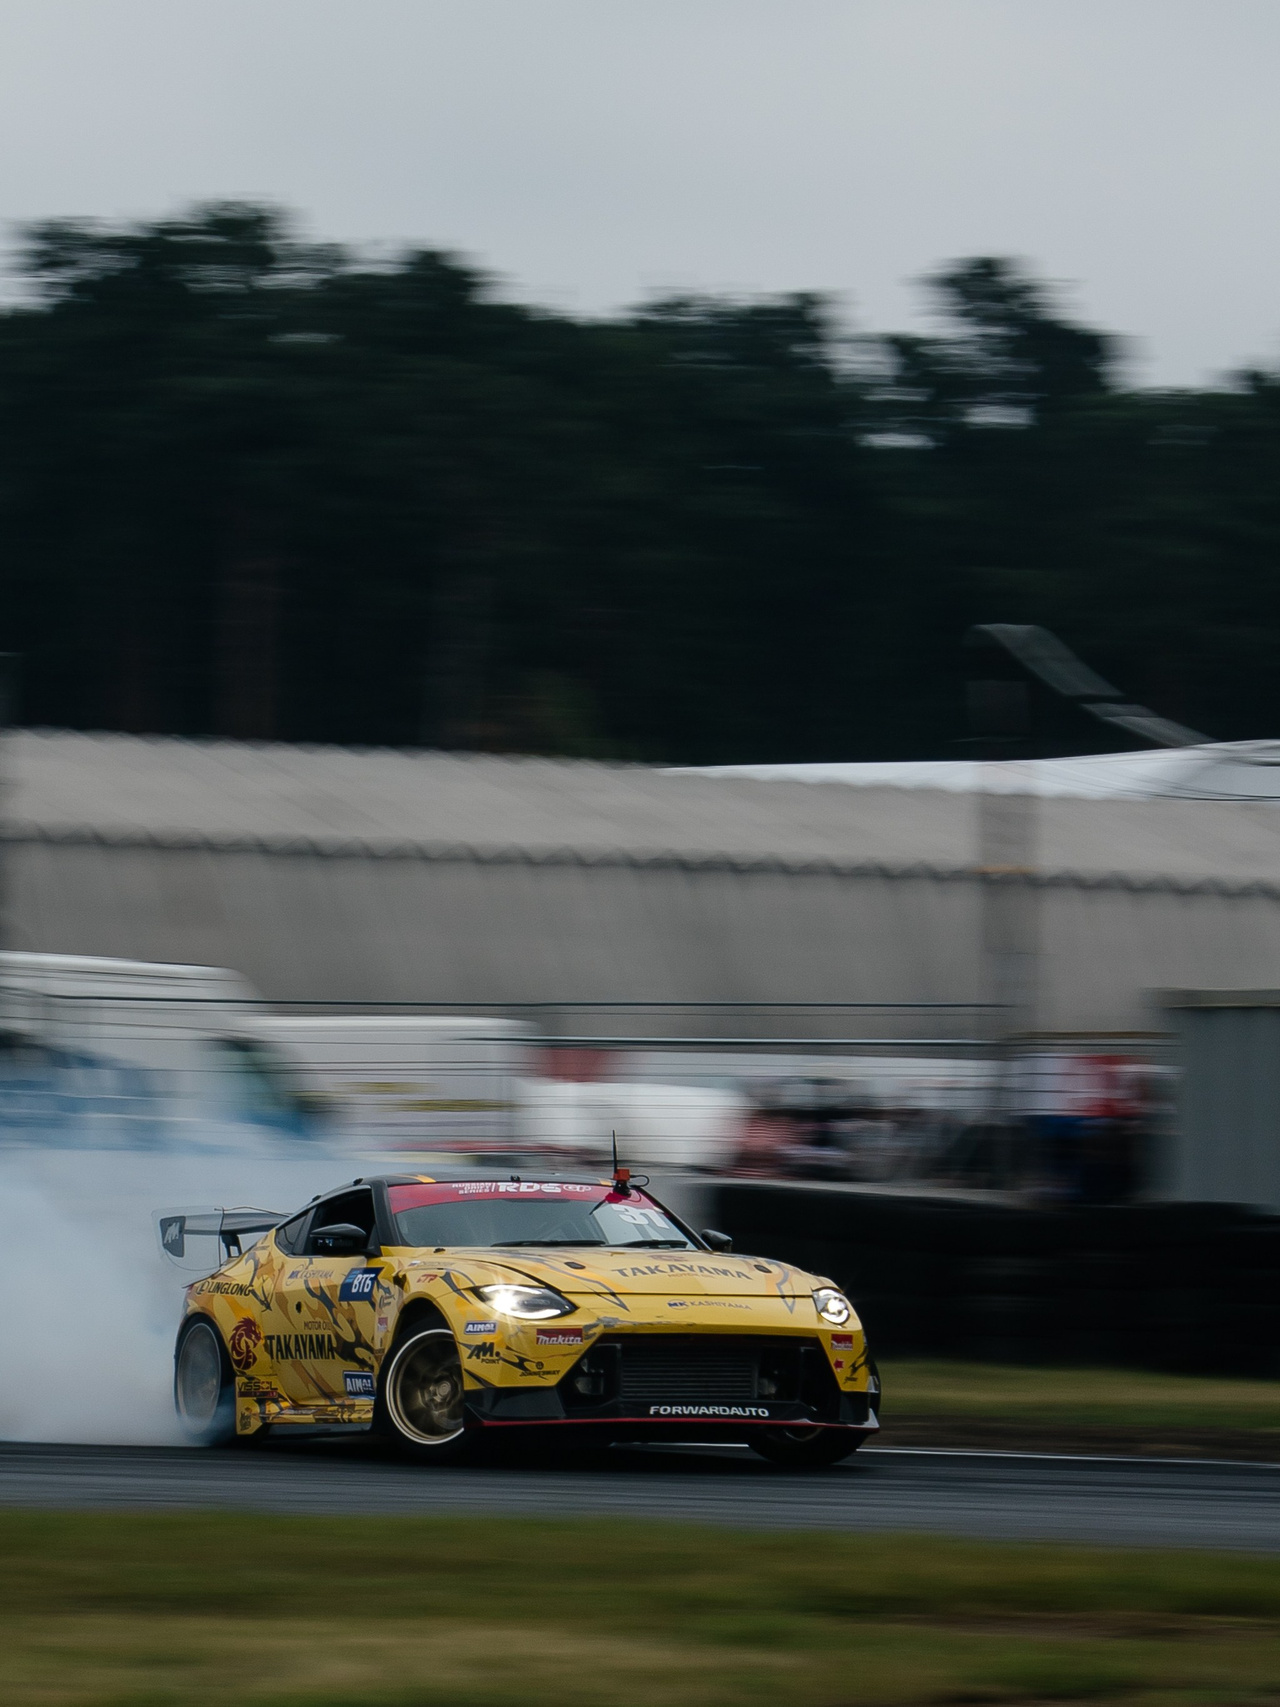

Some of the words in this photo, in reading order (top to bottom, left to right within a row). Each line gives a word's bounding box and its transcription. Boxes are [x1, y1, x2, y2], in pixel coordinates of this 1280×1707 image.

[611, 1203, 669, 1229] 31
[611, 1264, 754, 1281] TAKAYAMA
[208, 1281, 253, 1296] LINGLONG
[351, 1274, 376, 1293] ВТБ
[466, 1323, 496, 1332] AIMOL
[264, 1333, 336, 1360] TAKAYAMA
[649, 1405, 770, 1417] FORWARDAUTO
